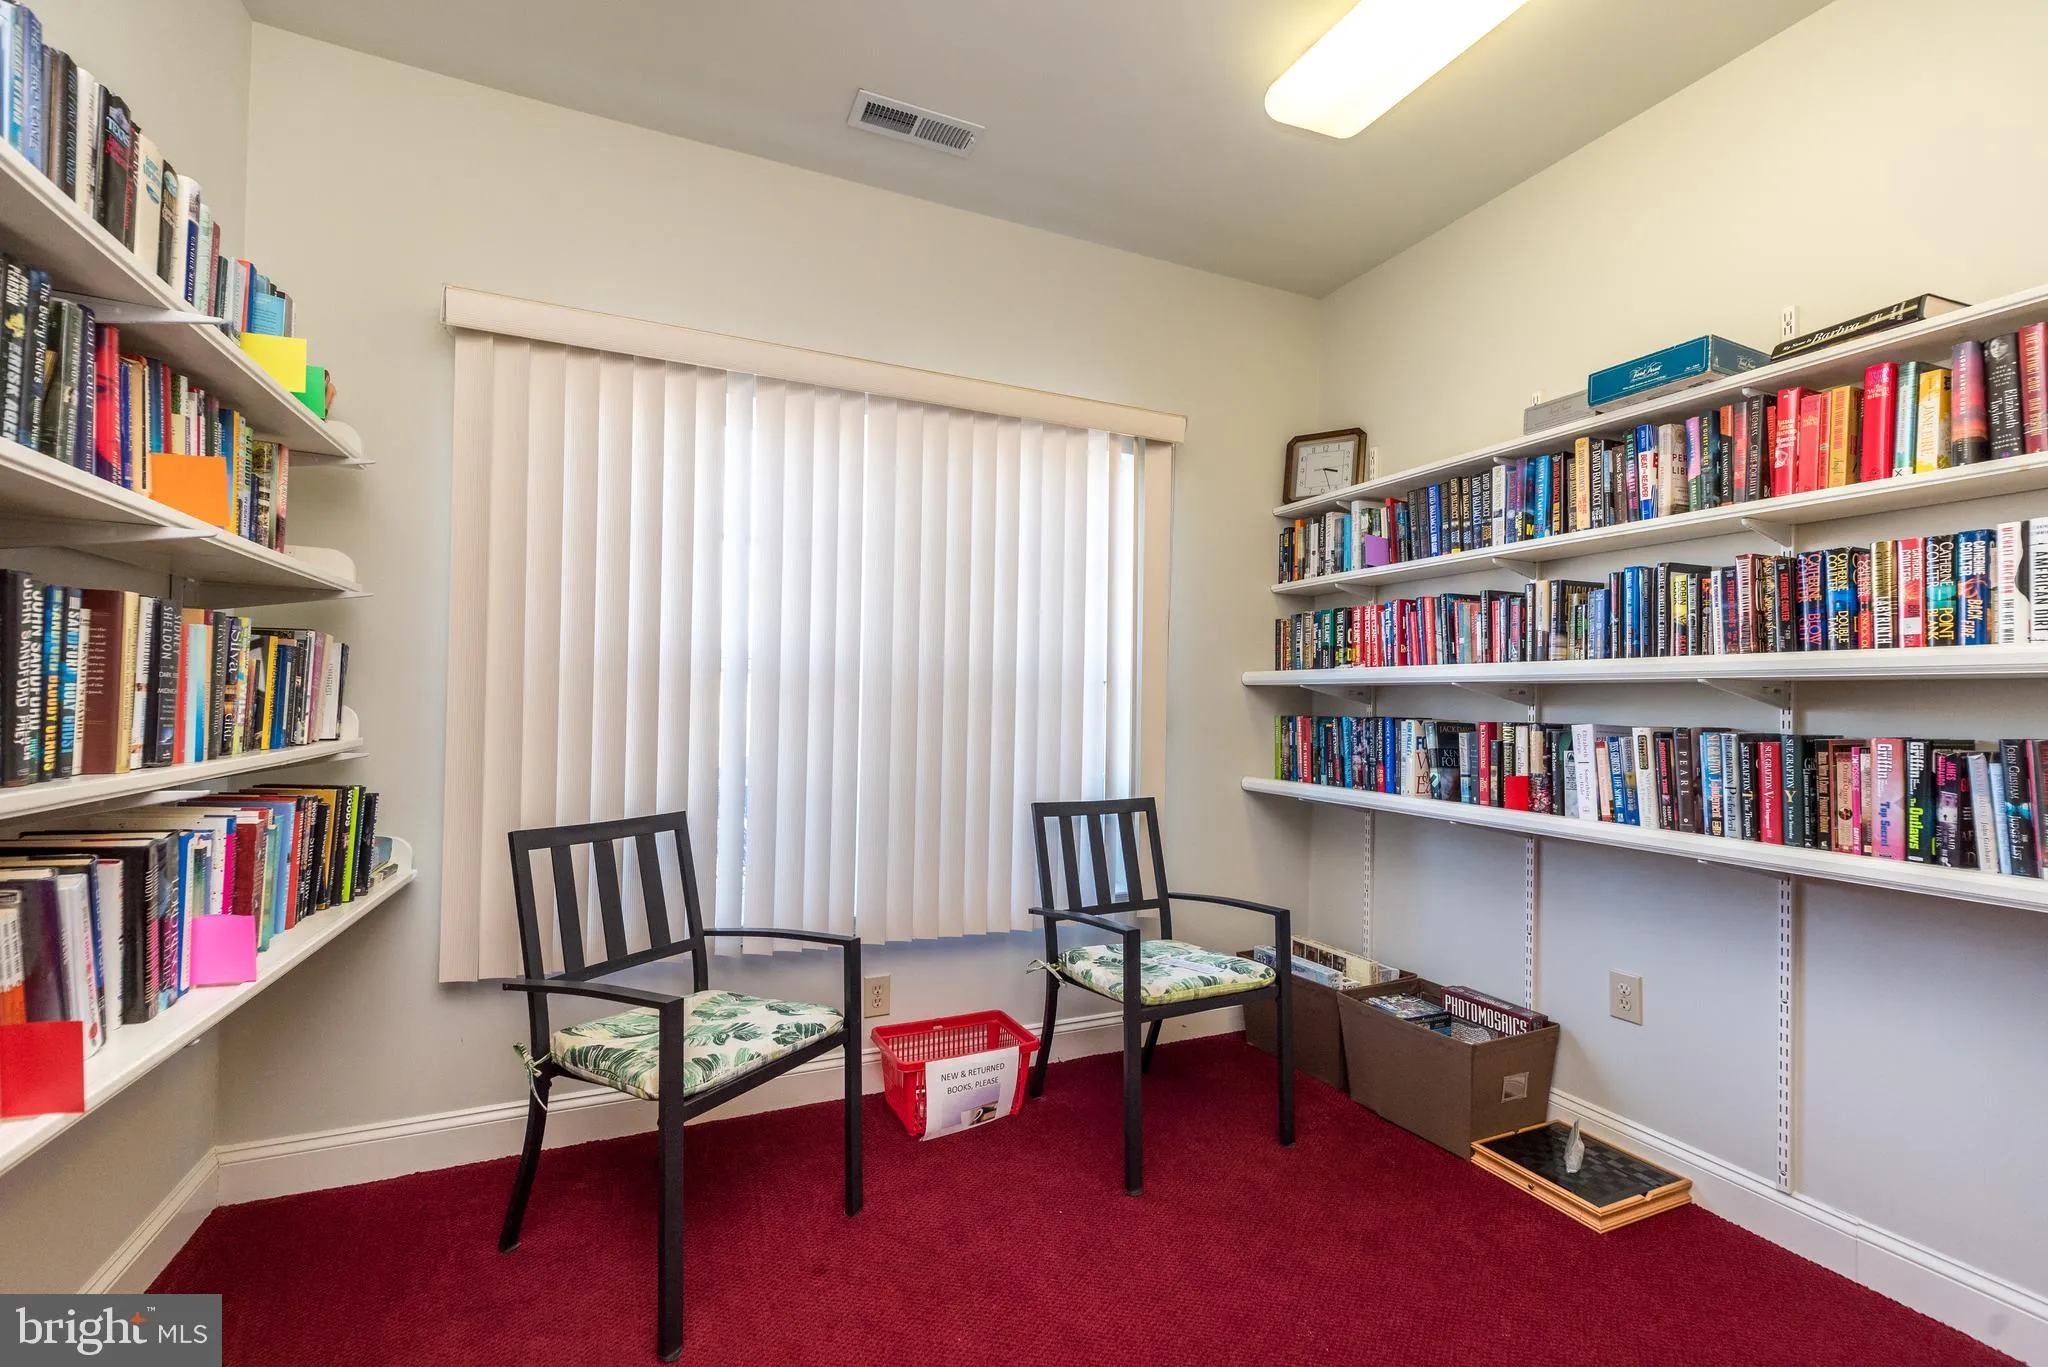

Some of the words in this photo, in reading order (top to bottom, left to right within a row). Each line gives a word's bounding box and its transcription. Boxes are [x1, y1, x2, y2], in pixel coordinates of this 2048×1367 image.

[34, 305, 49, 338] Berry
[1812, 322, 1860, 344] Barbra
[33, 341, 47, 383] Pickers
[86, 351, 94, 412] PICOULT
[2028, 376, 2040, 393] CODE
[1988, 398, 2004, 425] Taylor
[2004, 388, 2019, 429] Elizabeth
[1592, 450, 1601, 471] DAVID
[1593, 472, 1602, 506] BALDACCI
[1827, 555, 1837, 592] COULTER
[1837, 553, 1848, 591] CATHERINE
[1926, 543, 1938, 588] COULTER
[1939, 542, 1954, 586] CATHERINE
[1959, 542, 1970, 576] COULTER
[1974, 541, 1985, 575] CATHERINE
[1808, 554, 1821, 601] CATHERINE
[2034, 552, 2045, 605] AMERICAN
[21, 578, 33, 624] JOHN
[31, 591, 44, 636] JOHN
[162, 605, 174, 660] SHELDON
[1809, 614, 1821, 645] BLOW
[1828, 615, 1837, 639] TAKE
[1839, 611, 1849, 643] DOUBLE
[1876, 597, 1892, 644] LABYRINTH
[1939, 607, 1954, 640] POINT
[15, 630, 31, 707] SANDFORD
[229, 630, 241, 673] Silva
[224, 714, 234, 741] GIRL
[1503, 726, 1515, 743] ICON
[1725, 751, 1734, 784] GRAFTON
[1877, 744, 1893, 778] Griffin
[1910, 742, 1925, 778] Griffin
[2005, 745, 2018, 763] JOHN
[1679, 751, 1689, 796] PEARL
[1742, 759, 1751, 791] GRAFTON
[1764, 758, 1772, 789] GRAFTON
[1786, 754, 1795, 789] GRAFTON
[2008, 765, 2020, 799] GRISHAM
[345, 790, 354, 827] WOODS
[1743, 812, 1752, 837] Trespass
[1879, 801, 1891, 818] Top
[1880, 820, 1891, 847] Secret
[1909, 807, 1923, 849] Outlaws
[1444, 994, 1528, 1035] PHOTOMOSAICS
[940, 1072, 958, 1082] NEW
[960, 1070, 967, 1078] &
[968, 1062, 1005, 1077] RETURNED
[947, 1083, 973, 1095] BOOKS,
[975, 1077, 999, 1088] PLEASE
